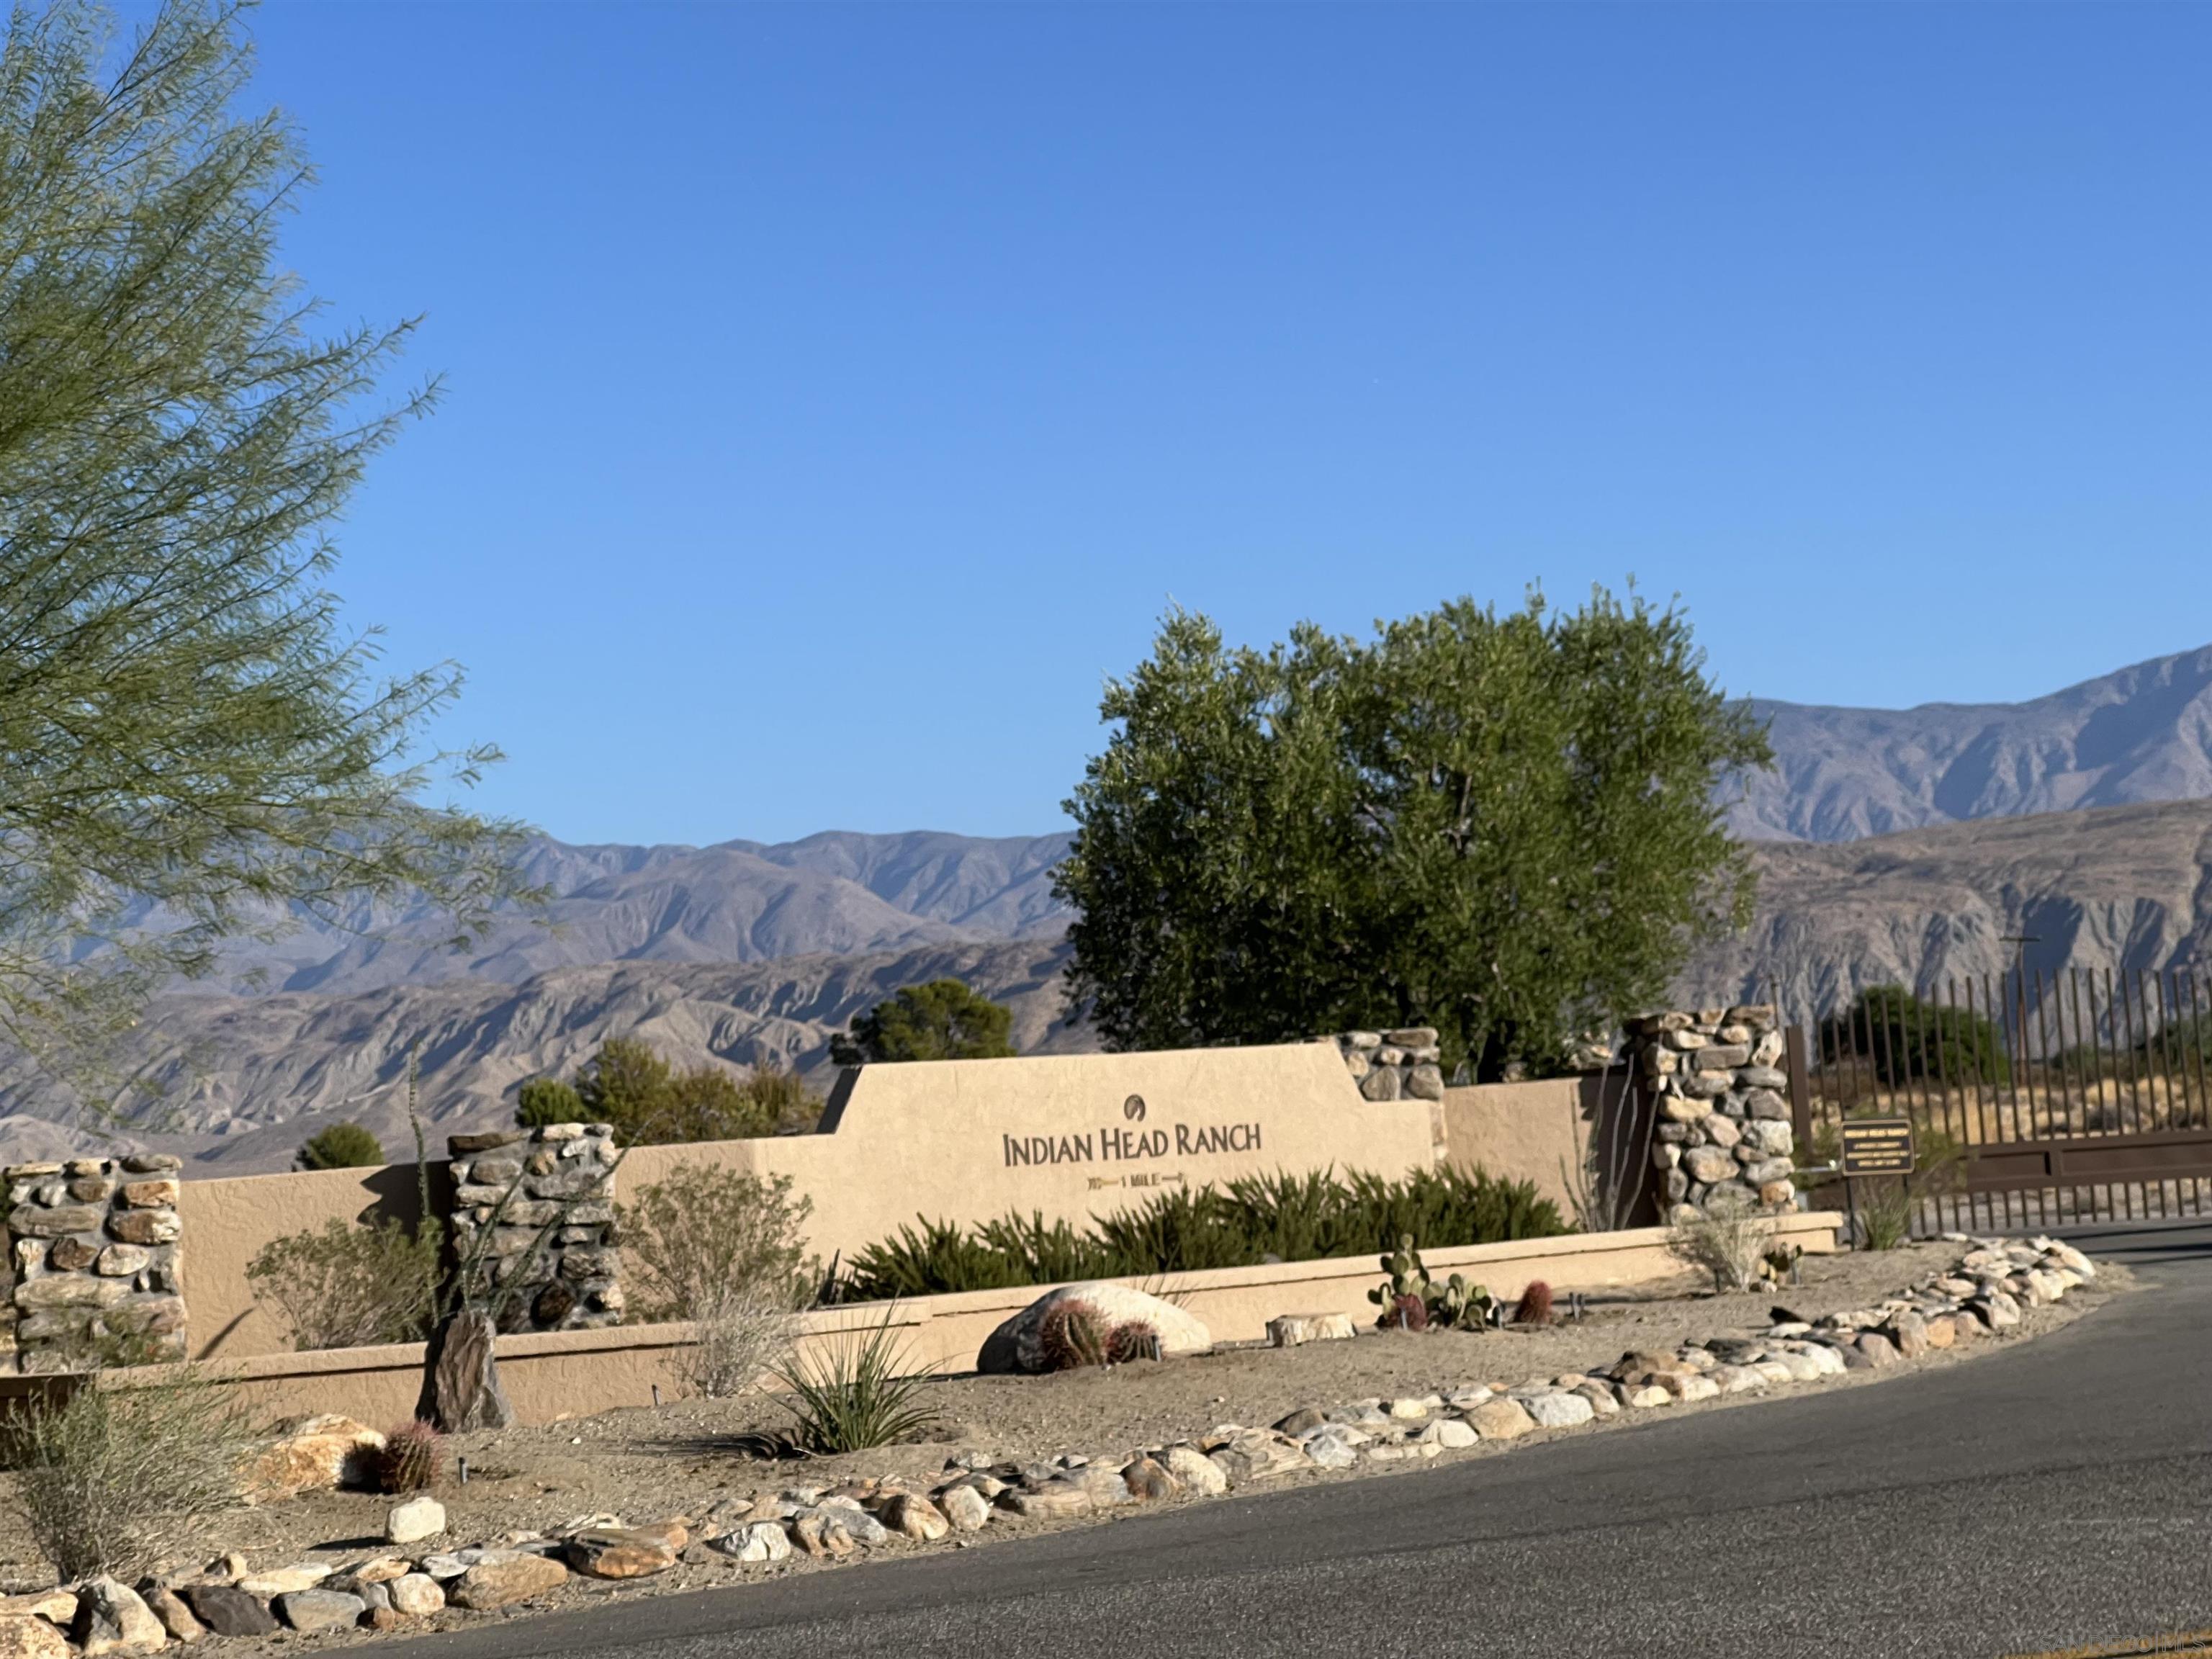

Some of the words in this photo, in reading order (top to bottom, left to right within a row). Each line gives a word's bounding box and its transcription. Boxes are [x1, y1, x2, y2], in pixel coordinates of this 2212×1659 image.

[1003, 1133, 1093, 1167] INDIAN
[1100, 1128, 1169, 1161] HEAD
[1175, 1123, 1262, 1156] RANCH
